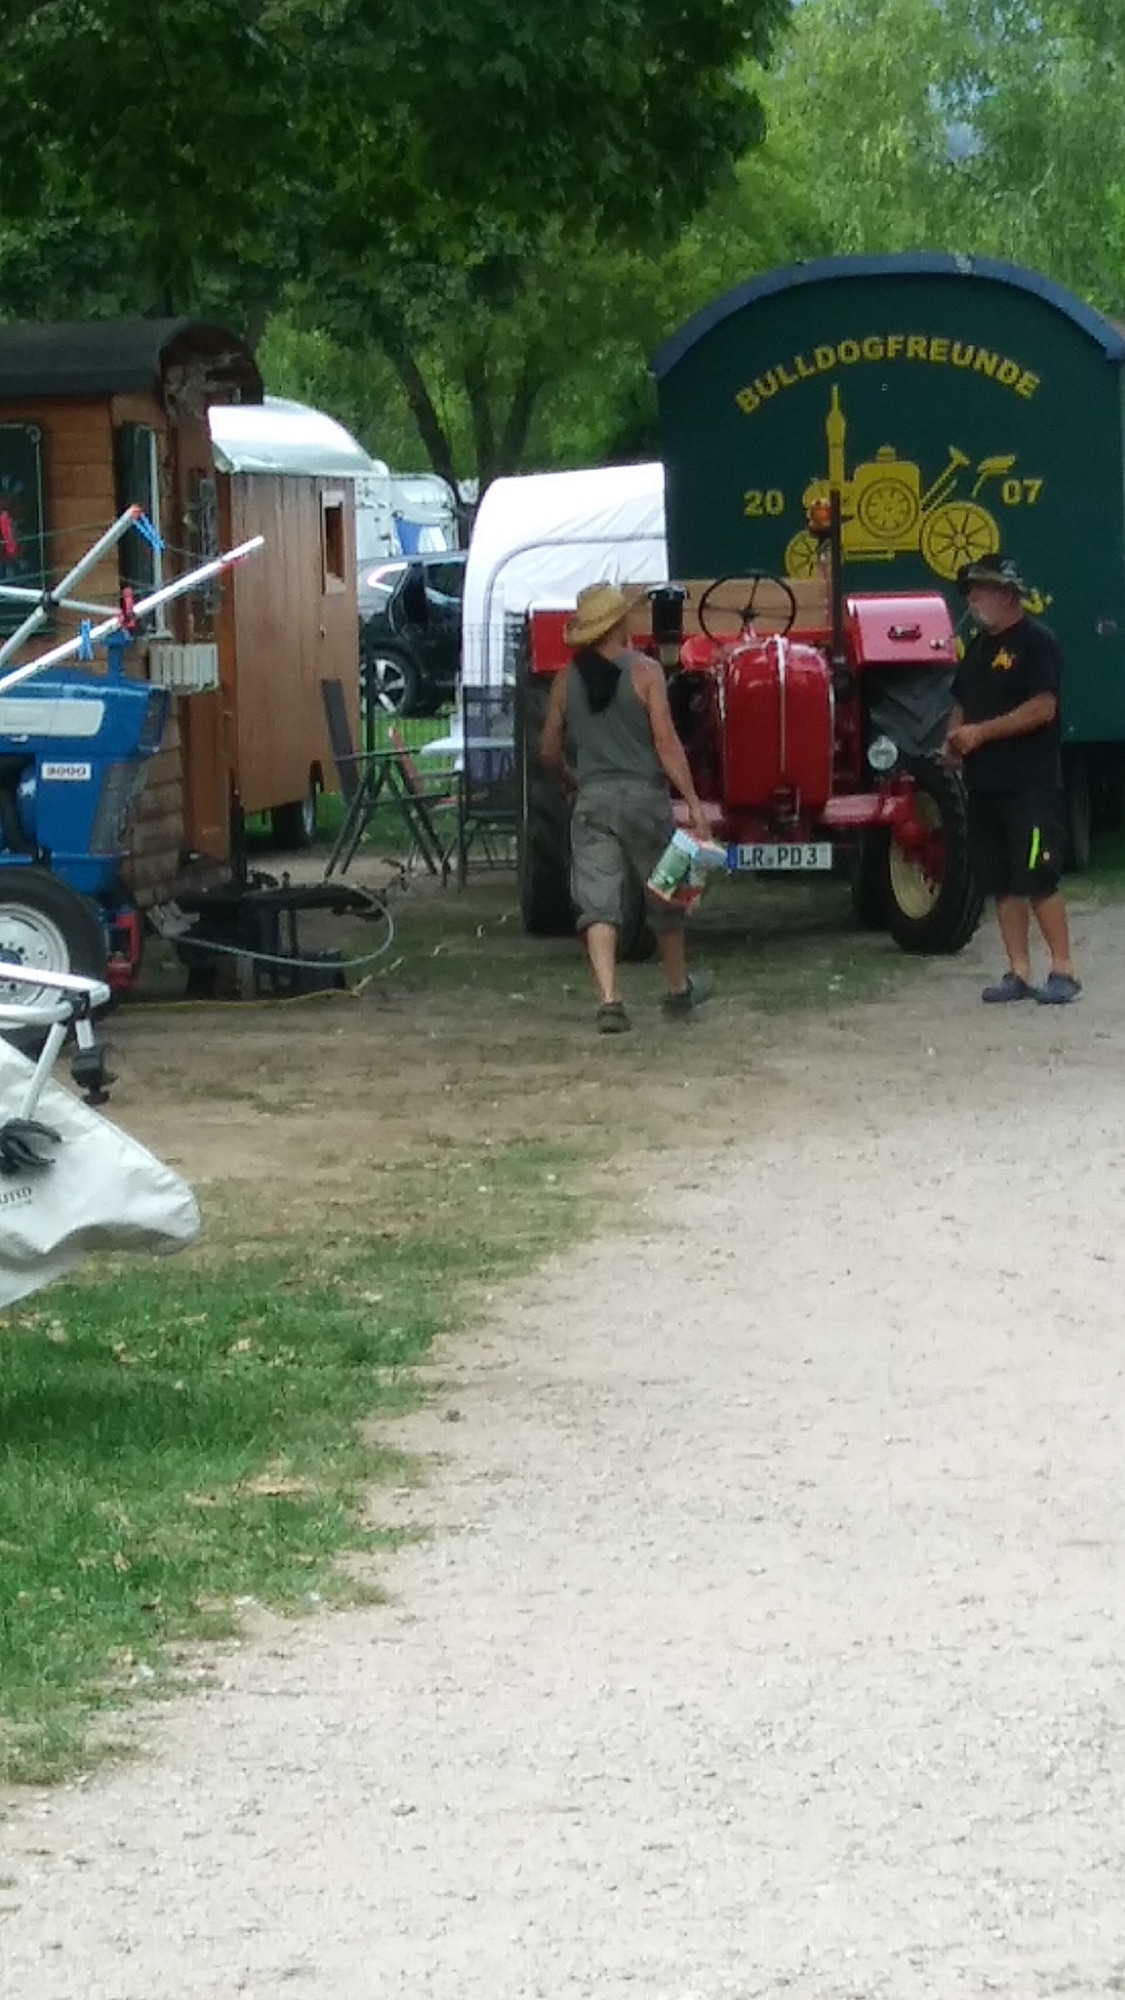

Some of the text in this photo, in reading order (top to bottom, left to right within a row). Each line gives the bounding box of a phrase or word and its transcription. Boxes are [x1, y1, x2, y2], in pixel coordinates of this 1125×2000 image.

[736, 335, 1040, 413] BULLDOGFREUNDE
[743, 480, 1042, 516] 20 07
